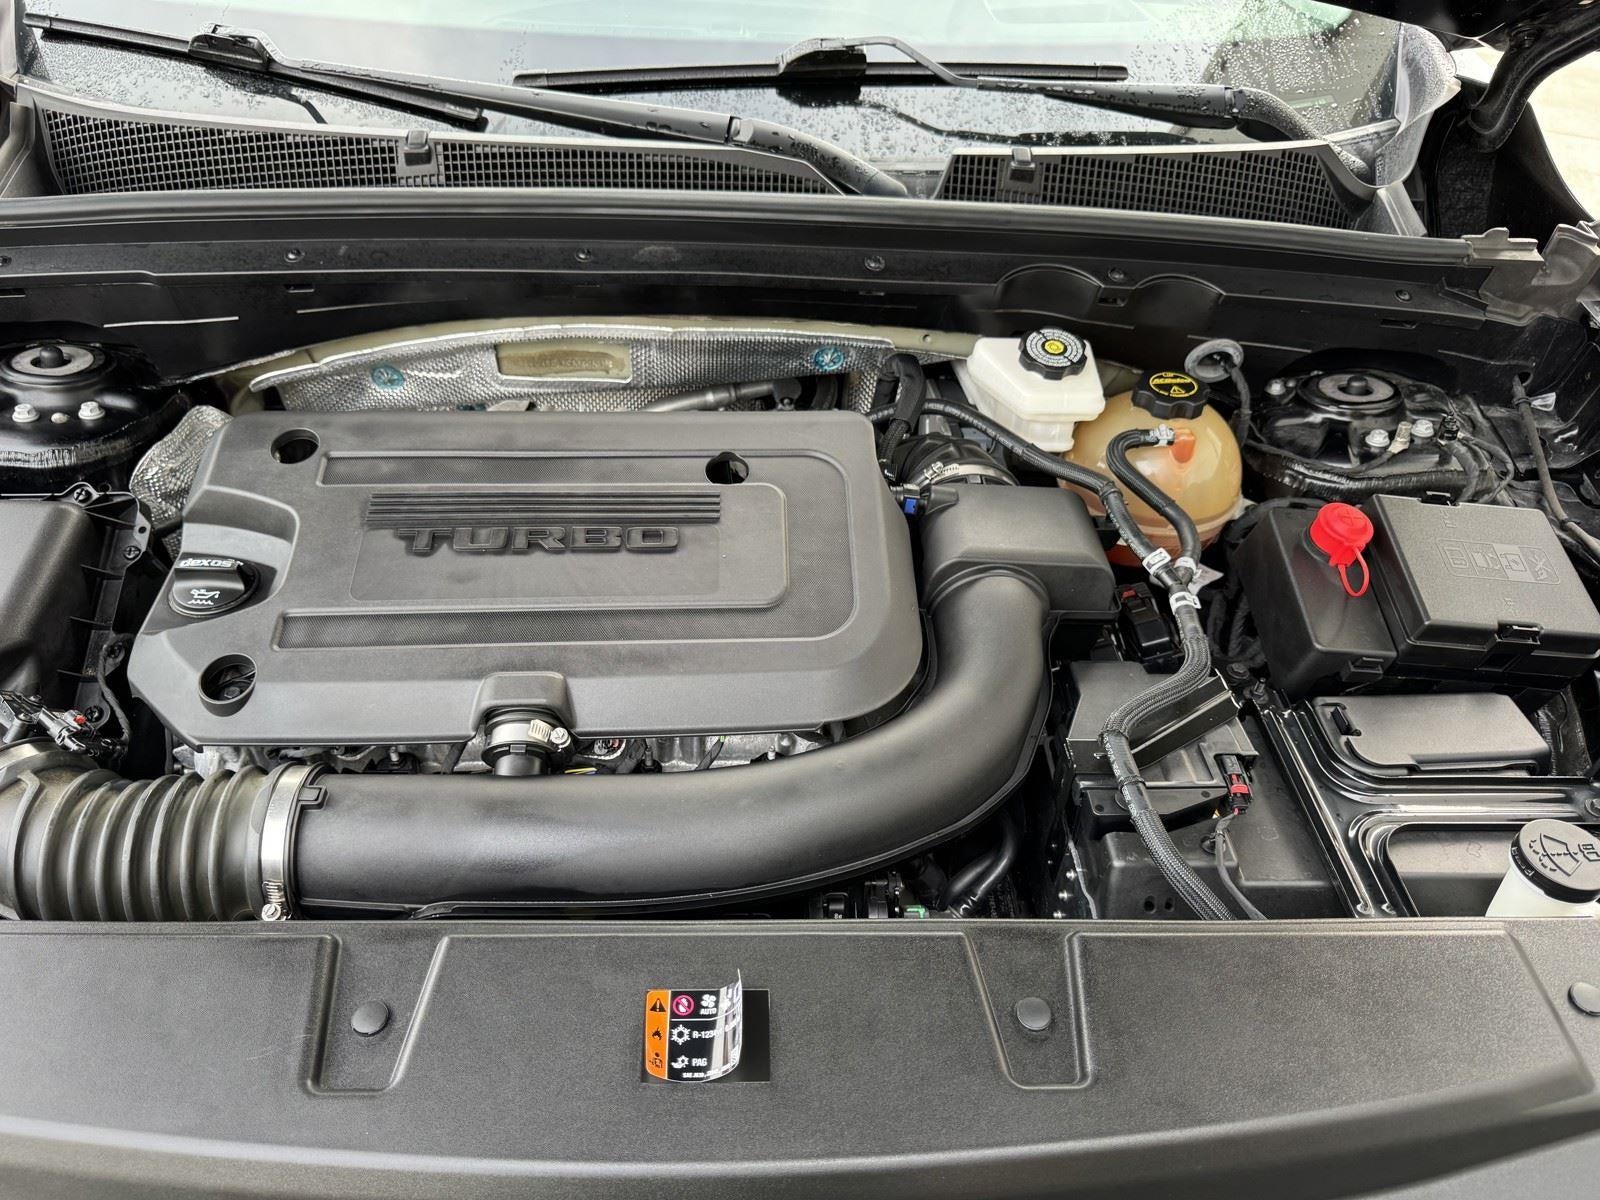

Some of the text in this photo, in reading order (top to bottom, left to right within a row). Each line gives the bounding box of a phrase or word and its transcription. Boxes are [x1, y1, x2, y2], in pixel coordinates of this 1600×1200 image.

[397, 525, 679, 553] TURBO
[179, 558, 233, 568] dexos
[692, 1058, 708, 1067] PAG
